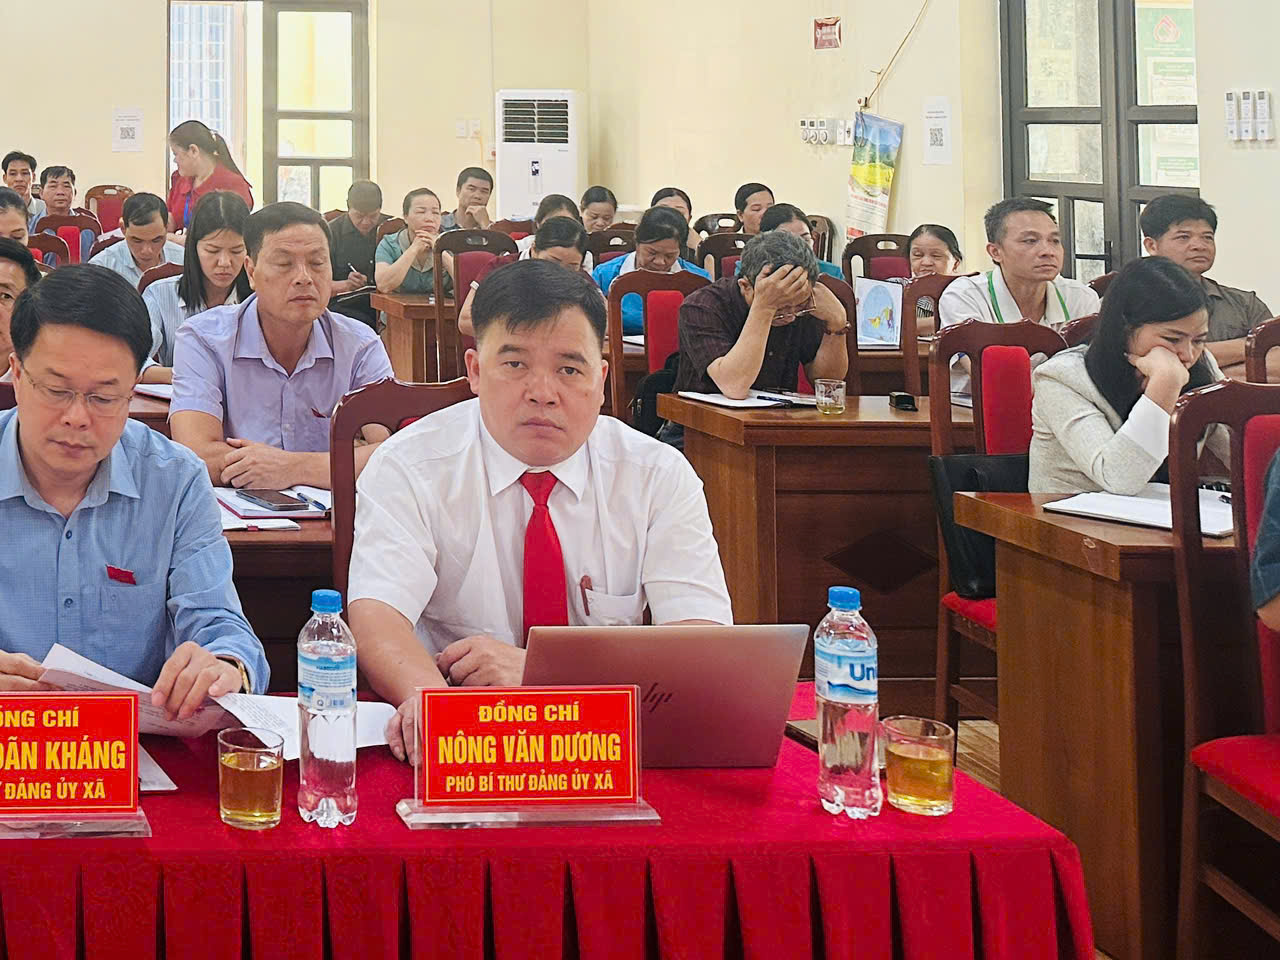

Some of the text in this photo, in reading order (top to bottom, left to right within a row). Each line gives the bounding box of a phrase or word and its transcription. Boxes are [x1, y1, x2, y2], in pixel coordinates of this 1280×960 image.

[849, 663, 878, 682] Un
[43, 707, 78, 727] CHÍ
[544, 702, 578, 721] CHÍ
[46, 735, 125, 769] KHÁNG
[439, 730, 620, 763] NÔNG VĂN DƯƠNG
[5, 778, 51, 799] ĐẢNG
[57, 777, 77, 798] ỦY
[84, 779, 105, 798] XÃ
[447, 769, 613, 792] PHÓ BÍ THƯ ĐẢNG ỦY XÃ
